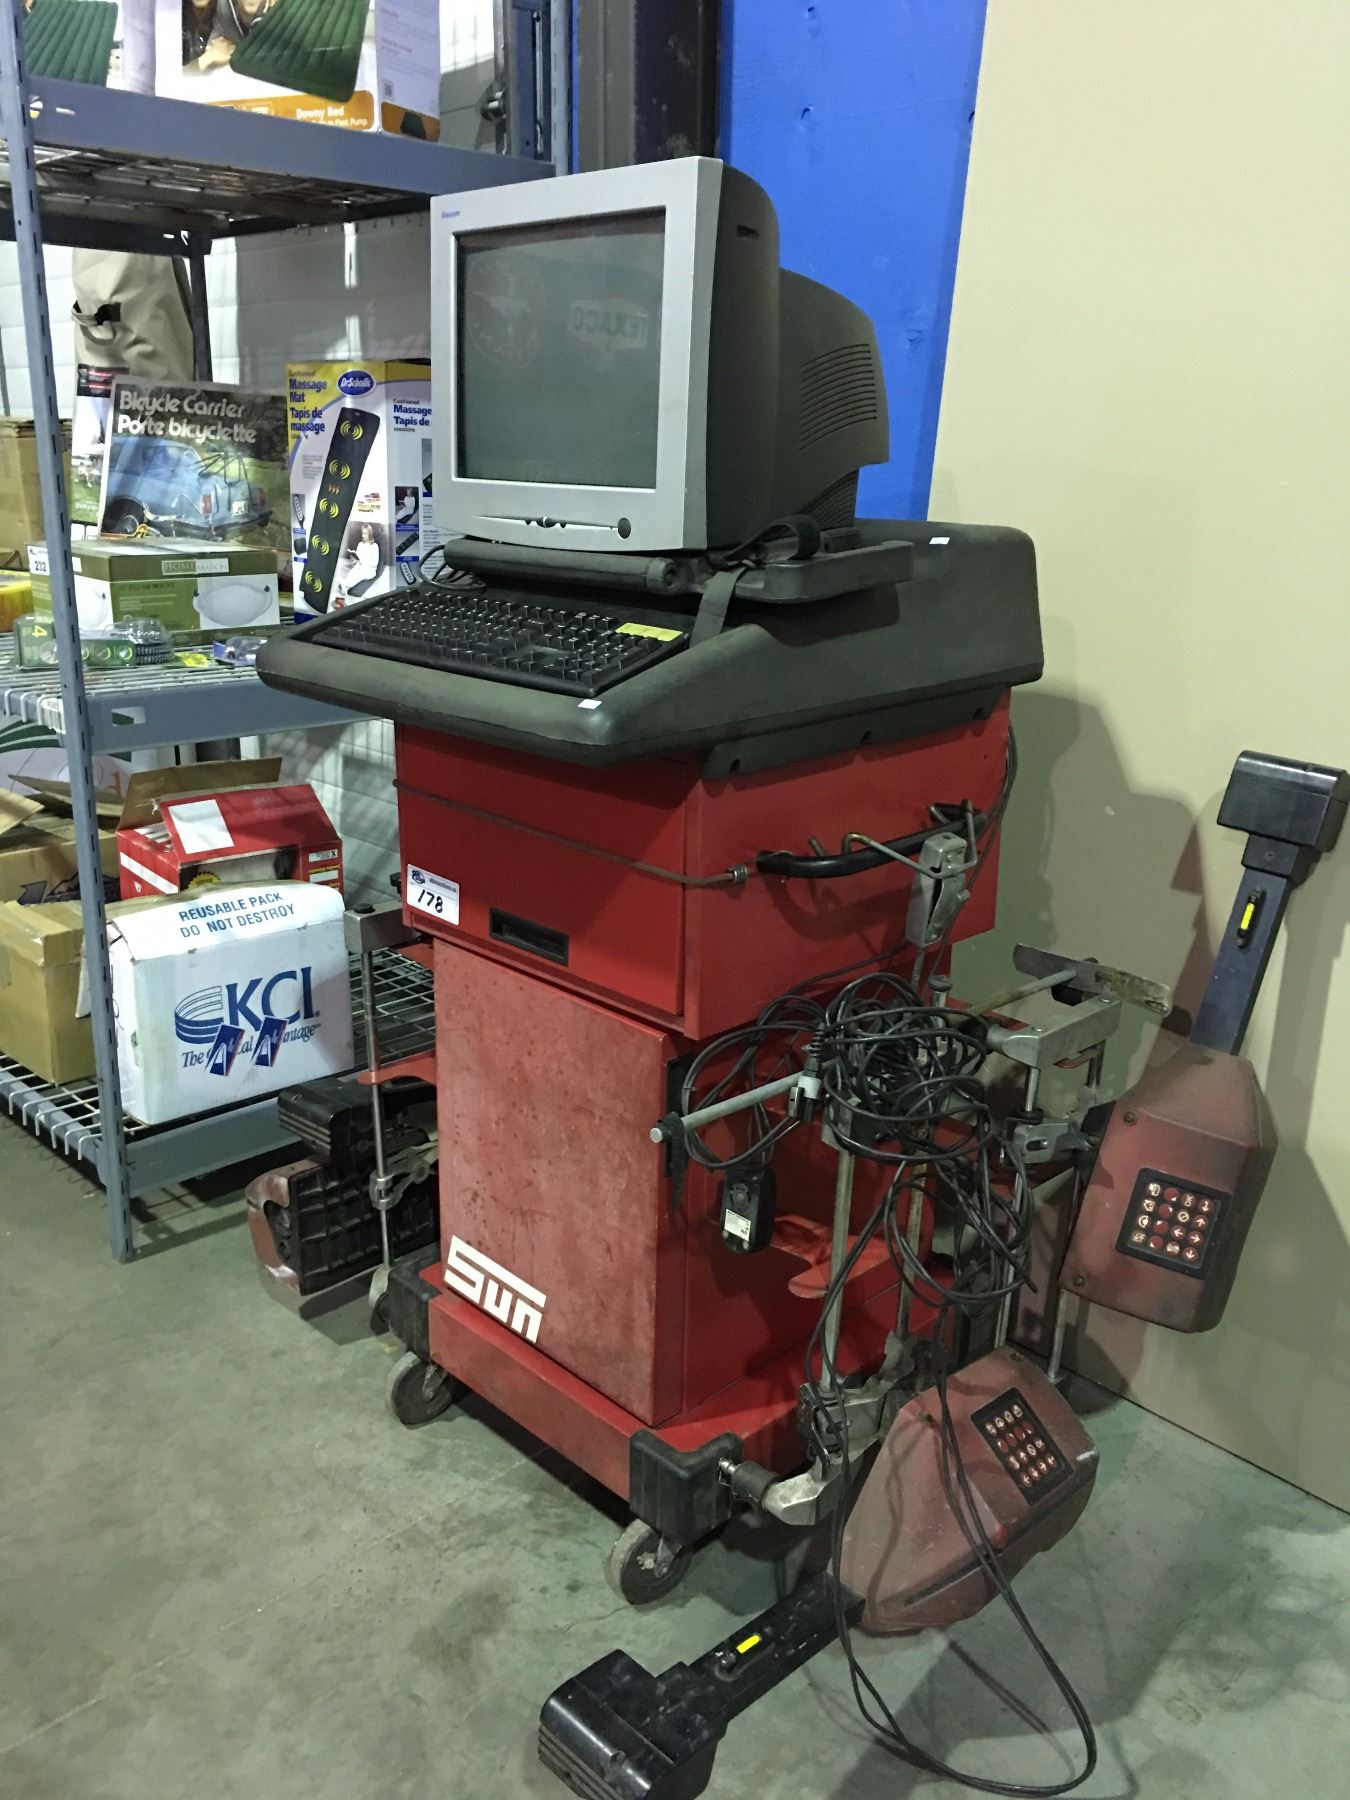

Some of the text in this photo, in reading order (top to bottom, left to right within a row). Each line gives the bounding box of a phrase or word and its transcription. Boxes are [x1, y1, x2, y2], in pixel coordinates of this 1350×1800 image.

[296, 106, 344, 120] Downy Bed
[289, 379, 327, 392] Massage
[120, 390, 246, 418] Bicycle Carrier
[290, 392, 305, 402] Mat
[290, 407, 323, 420] Tapis de
[394, 404, 432, 416] Massage
[291, 422, 325, 435] massage
[394, 416, 430, 427] Tapis de
[118, 414, 257, 444] Porte bicyclette
[35, 561, 47, 571] 232
[179, 892, 284, 921] REUSABLE PACK
[417, 888, 443, 913] 178
[180, 903, 295, 938] DO NOT DESTROY
[225, 966, 315, 1032] KCI
[182, 1049, 205, 1068] The
